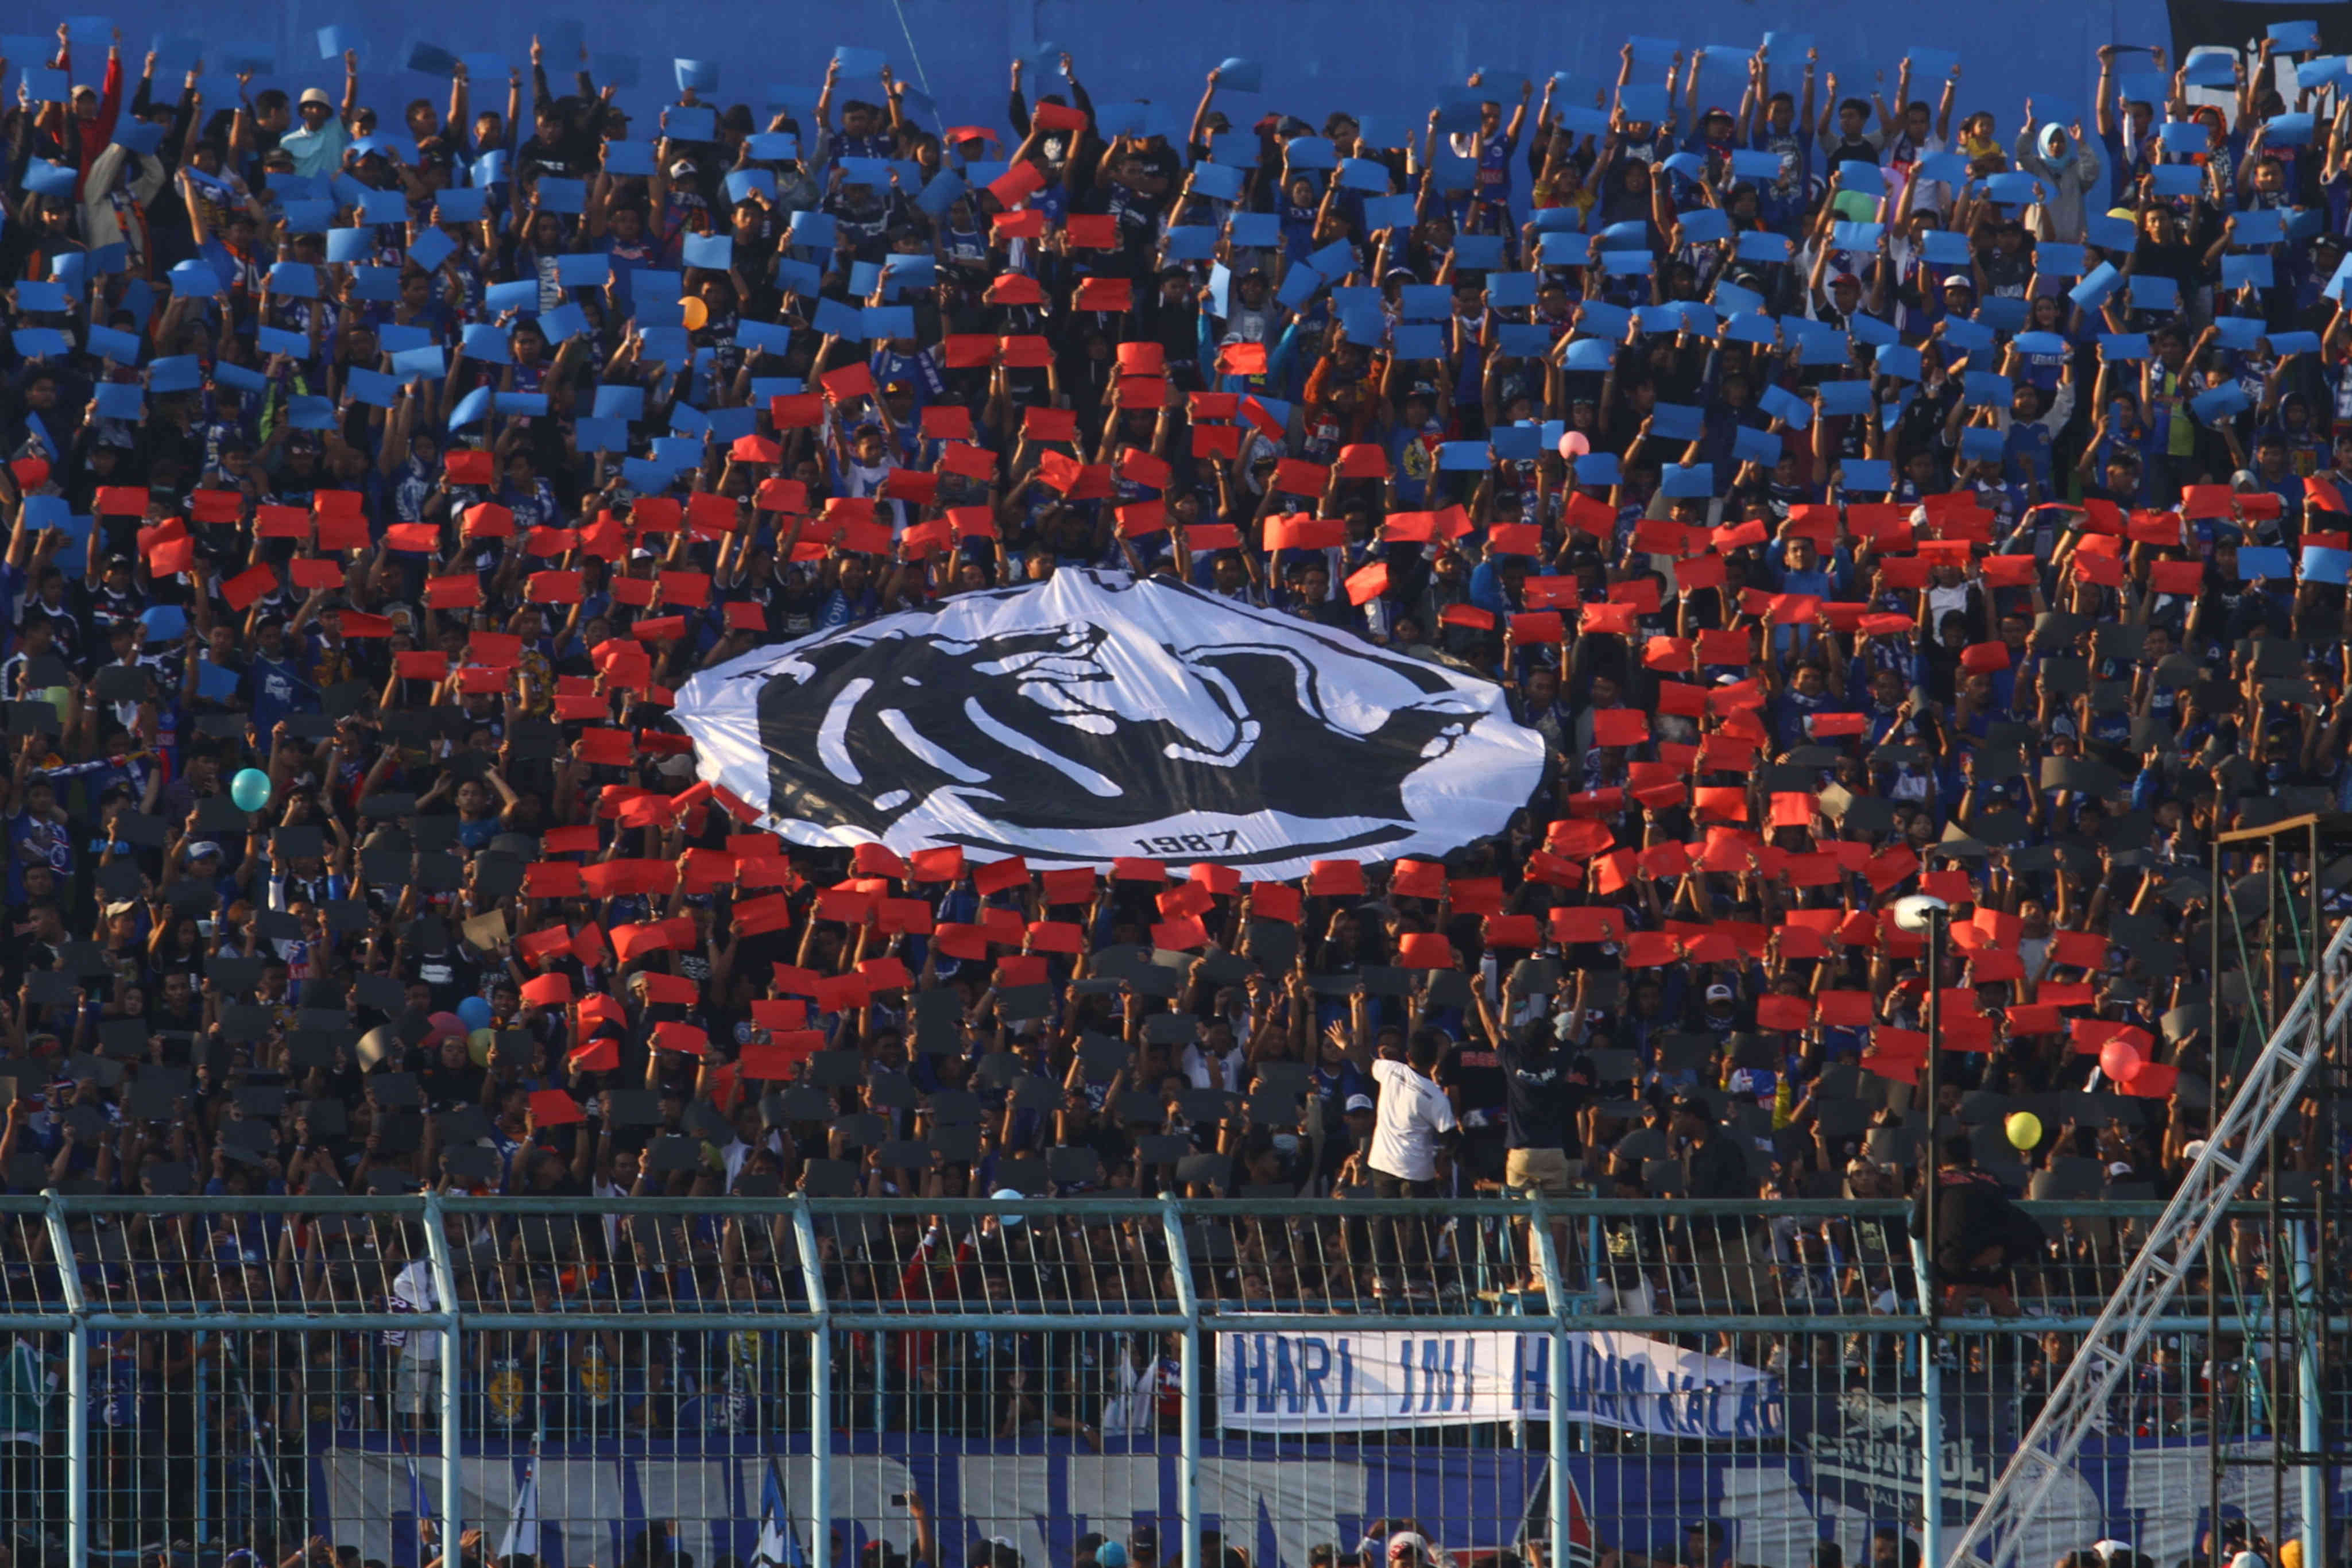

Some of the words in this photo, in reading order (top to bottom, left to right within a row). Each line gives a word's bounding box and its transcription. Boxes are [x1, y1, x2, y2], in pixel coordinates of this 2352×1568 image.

[1133, 830, 1237, 855] 1987
[1233, 1334, 1353, 1414] HARI
[1399, 1338, 1475, 1413] INI
